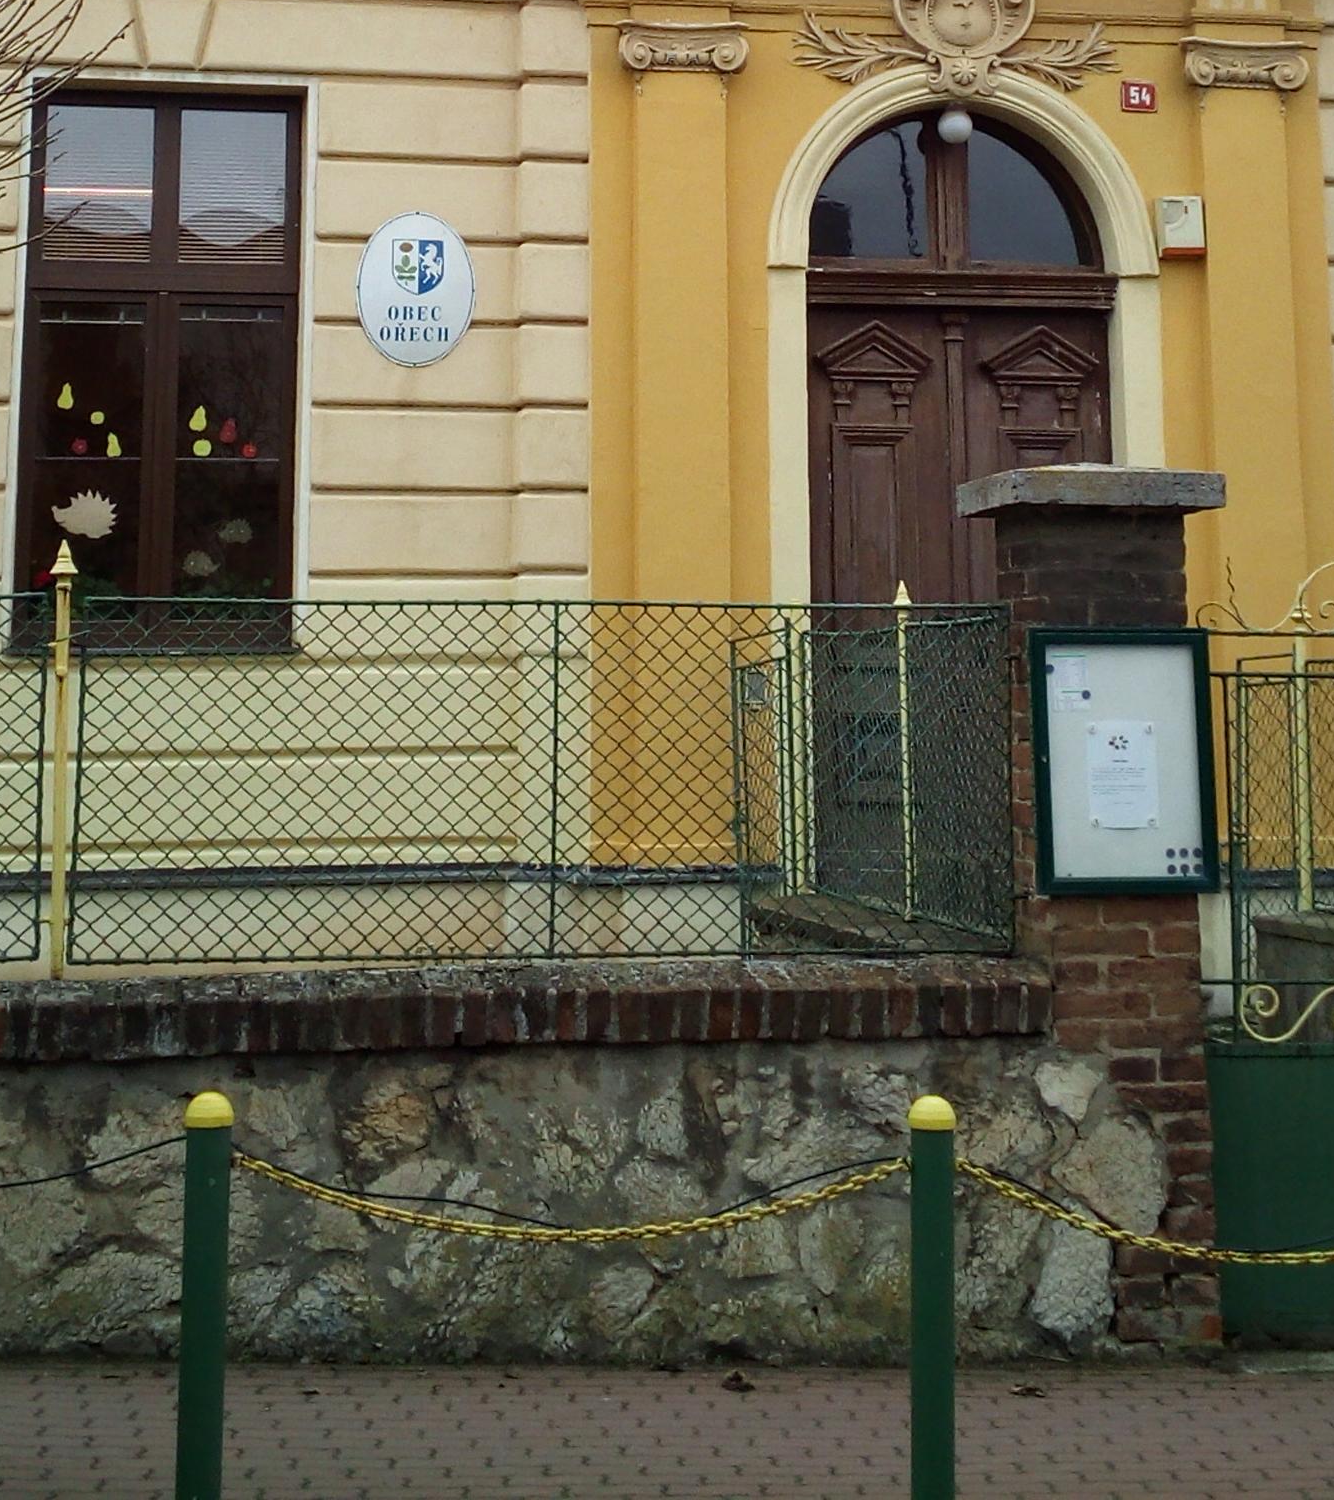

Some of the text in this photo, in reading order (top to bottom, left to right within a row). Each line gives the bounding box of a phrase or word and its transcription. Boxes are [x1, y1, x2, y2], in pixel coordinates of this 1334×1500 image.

[1130, 86, 1151, 106] 54
[387, 305, 443, 322] OBEC
[379, 322, 450, 343] OŘECH
